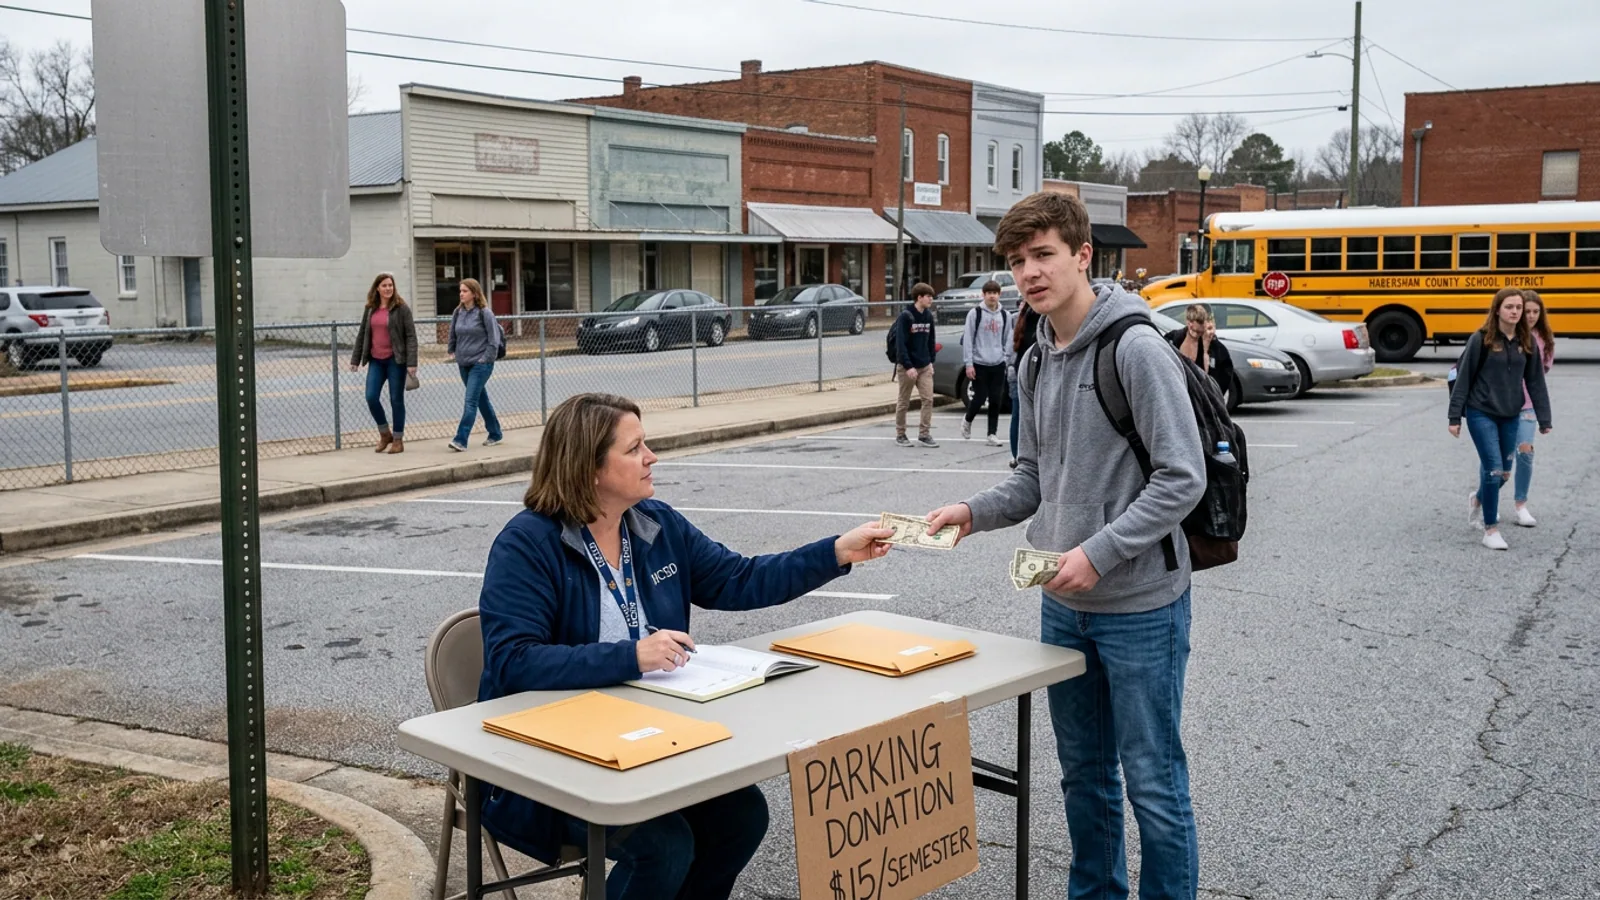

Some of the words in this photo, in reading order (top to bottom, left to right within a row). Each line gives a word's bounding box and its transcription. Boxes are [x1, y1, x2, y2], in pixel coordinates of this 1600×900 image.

[1425, 277, 1460, 287] COUNTY
[1465, 276, 1500, 287] SCHOOL
[805, 722, 942, 817] PARKING
[825, 771, 954, 859] DONATION
